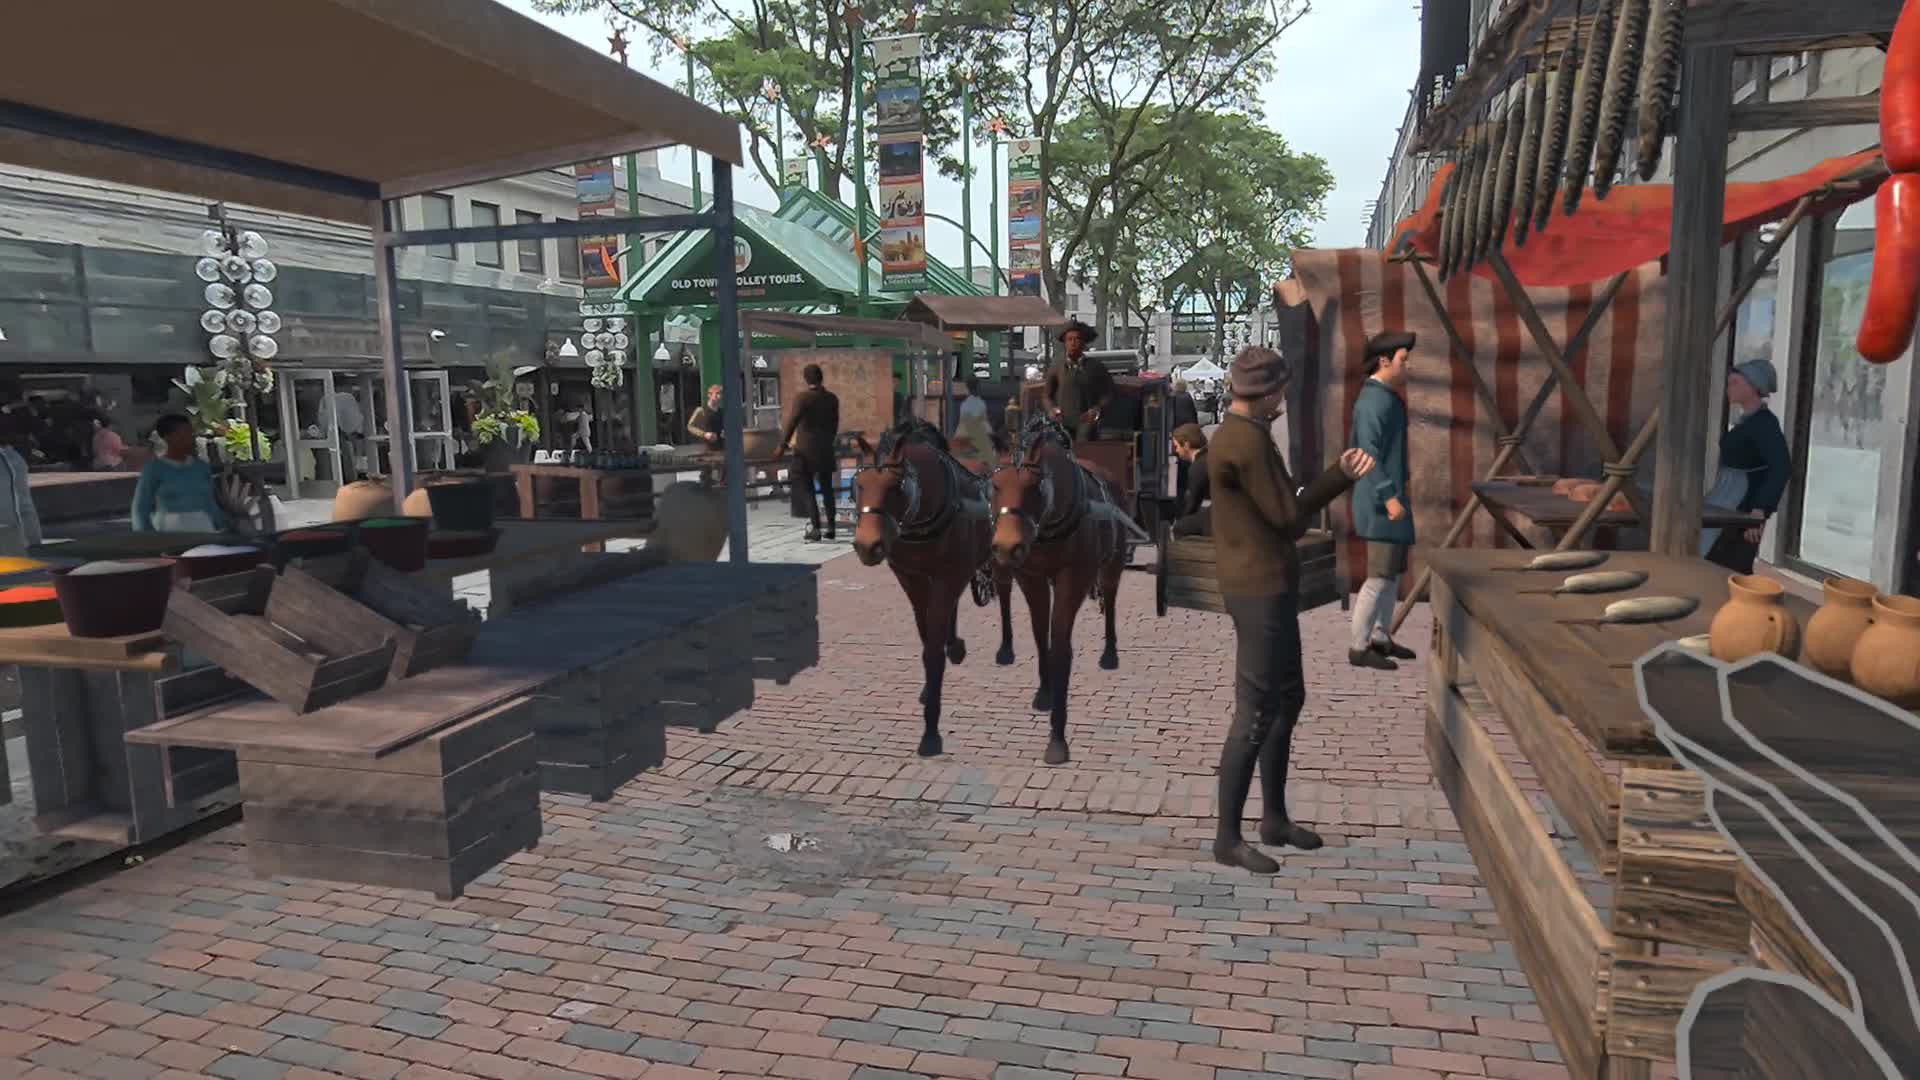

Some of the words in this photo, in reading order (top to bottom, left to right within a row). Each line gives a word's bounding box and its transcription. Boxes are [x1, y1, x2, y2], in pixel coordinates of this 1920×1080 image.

[672, 279, 692, 289] OLD
[735, 275, 766, 286] OLLEY
[769, 273, 805, 284] TOURS.
